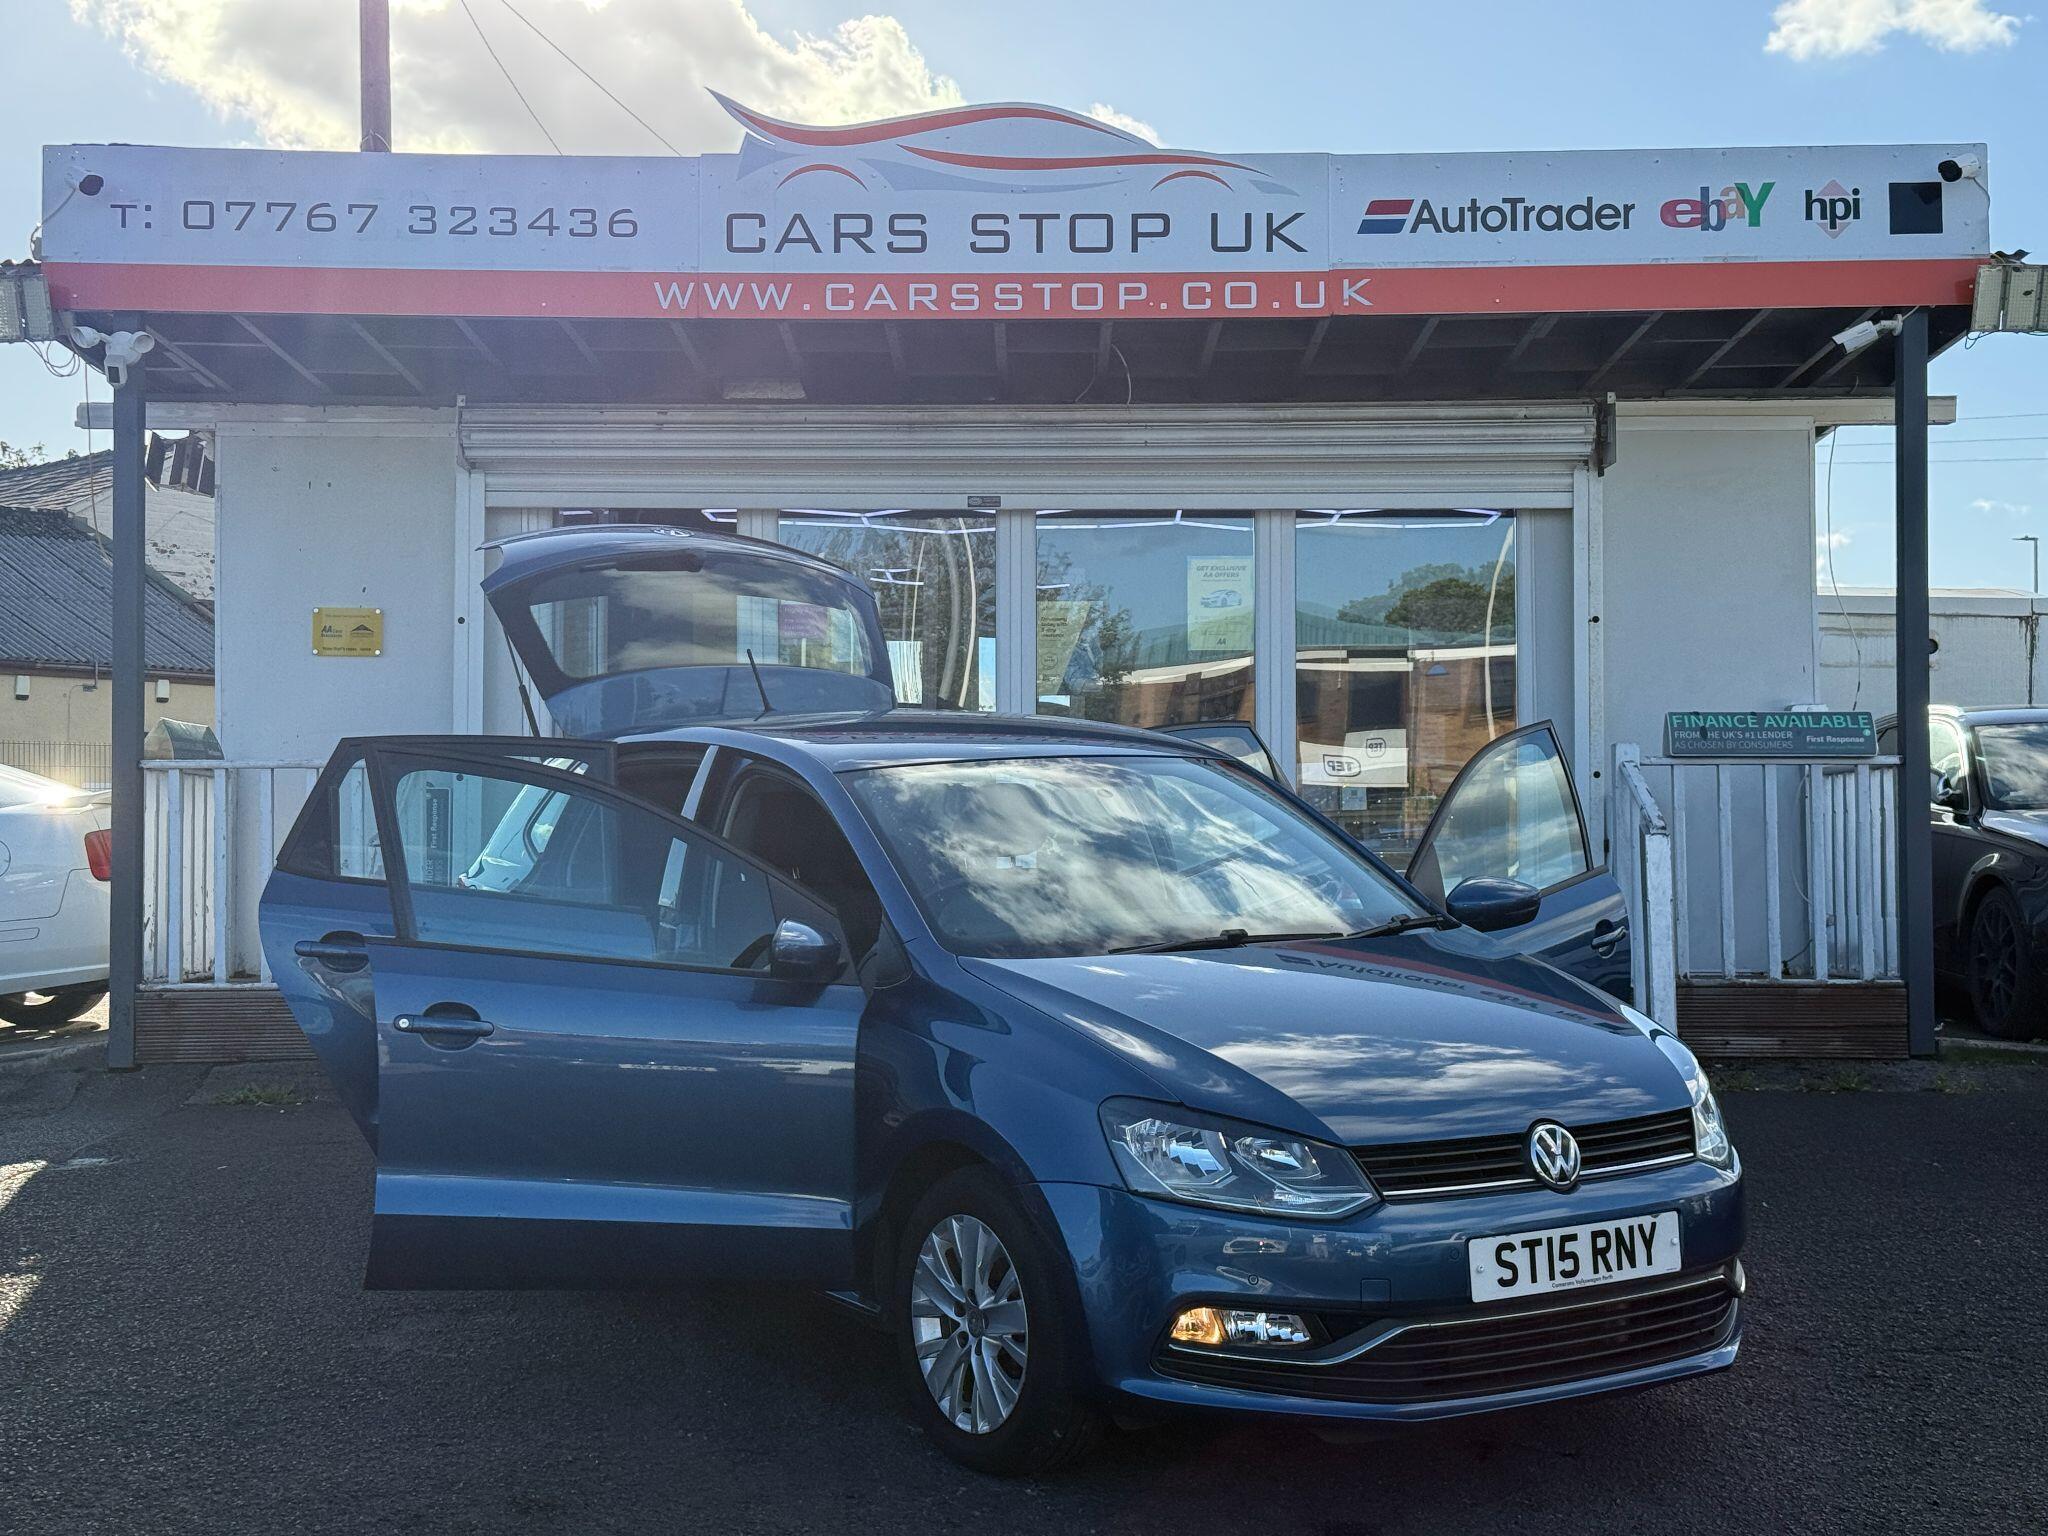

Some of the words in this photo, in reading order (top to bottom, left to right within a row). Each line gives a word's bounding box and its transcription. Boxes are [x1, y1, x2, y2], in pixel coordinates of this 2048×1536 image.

[110, 203, 153, 230] T:
[182, 199, 380, 235] 07767
[407, 203, 640, 239] 323436
[1410, 196, 1637, 234] AutoTrader
[1804, 185, 1862, 231] hpi
[725, 212, 929, 255] CARS
[969, 211, 1171, 255] STOP
[1210, 211, 1309, 253] UK
[653, 278, 1375, 314] WWW.CARSSTOP.CO.UK
[1672, 714, 1759, 728] FINANCE
[1764, 714, 1871, 728] AVAILABLE
[1674, 730, 1700, 739] FROM
[1703, 730, 1721, 739] HE
[1722, 730, 1744, 739] UK'S
[1745, 731, 1756, 739] #1
[1757, 730, 1793, 739] LENDER
[1674, 740, 1686, 750] AS
[1687, 740, 1725, 750] CHOSEN
[1726, 740, 1739, 750] BY
[1739, 740, 1794, 750] CONSUMERS
[1806, 735, 1825, 743] First
[1826, 735, 1865, 744] Response
[430, 798, 439, 832] Response
[430, 833, 438, 849] First
[1590, 1221, 1658, 1275] RNY
